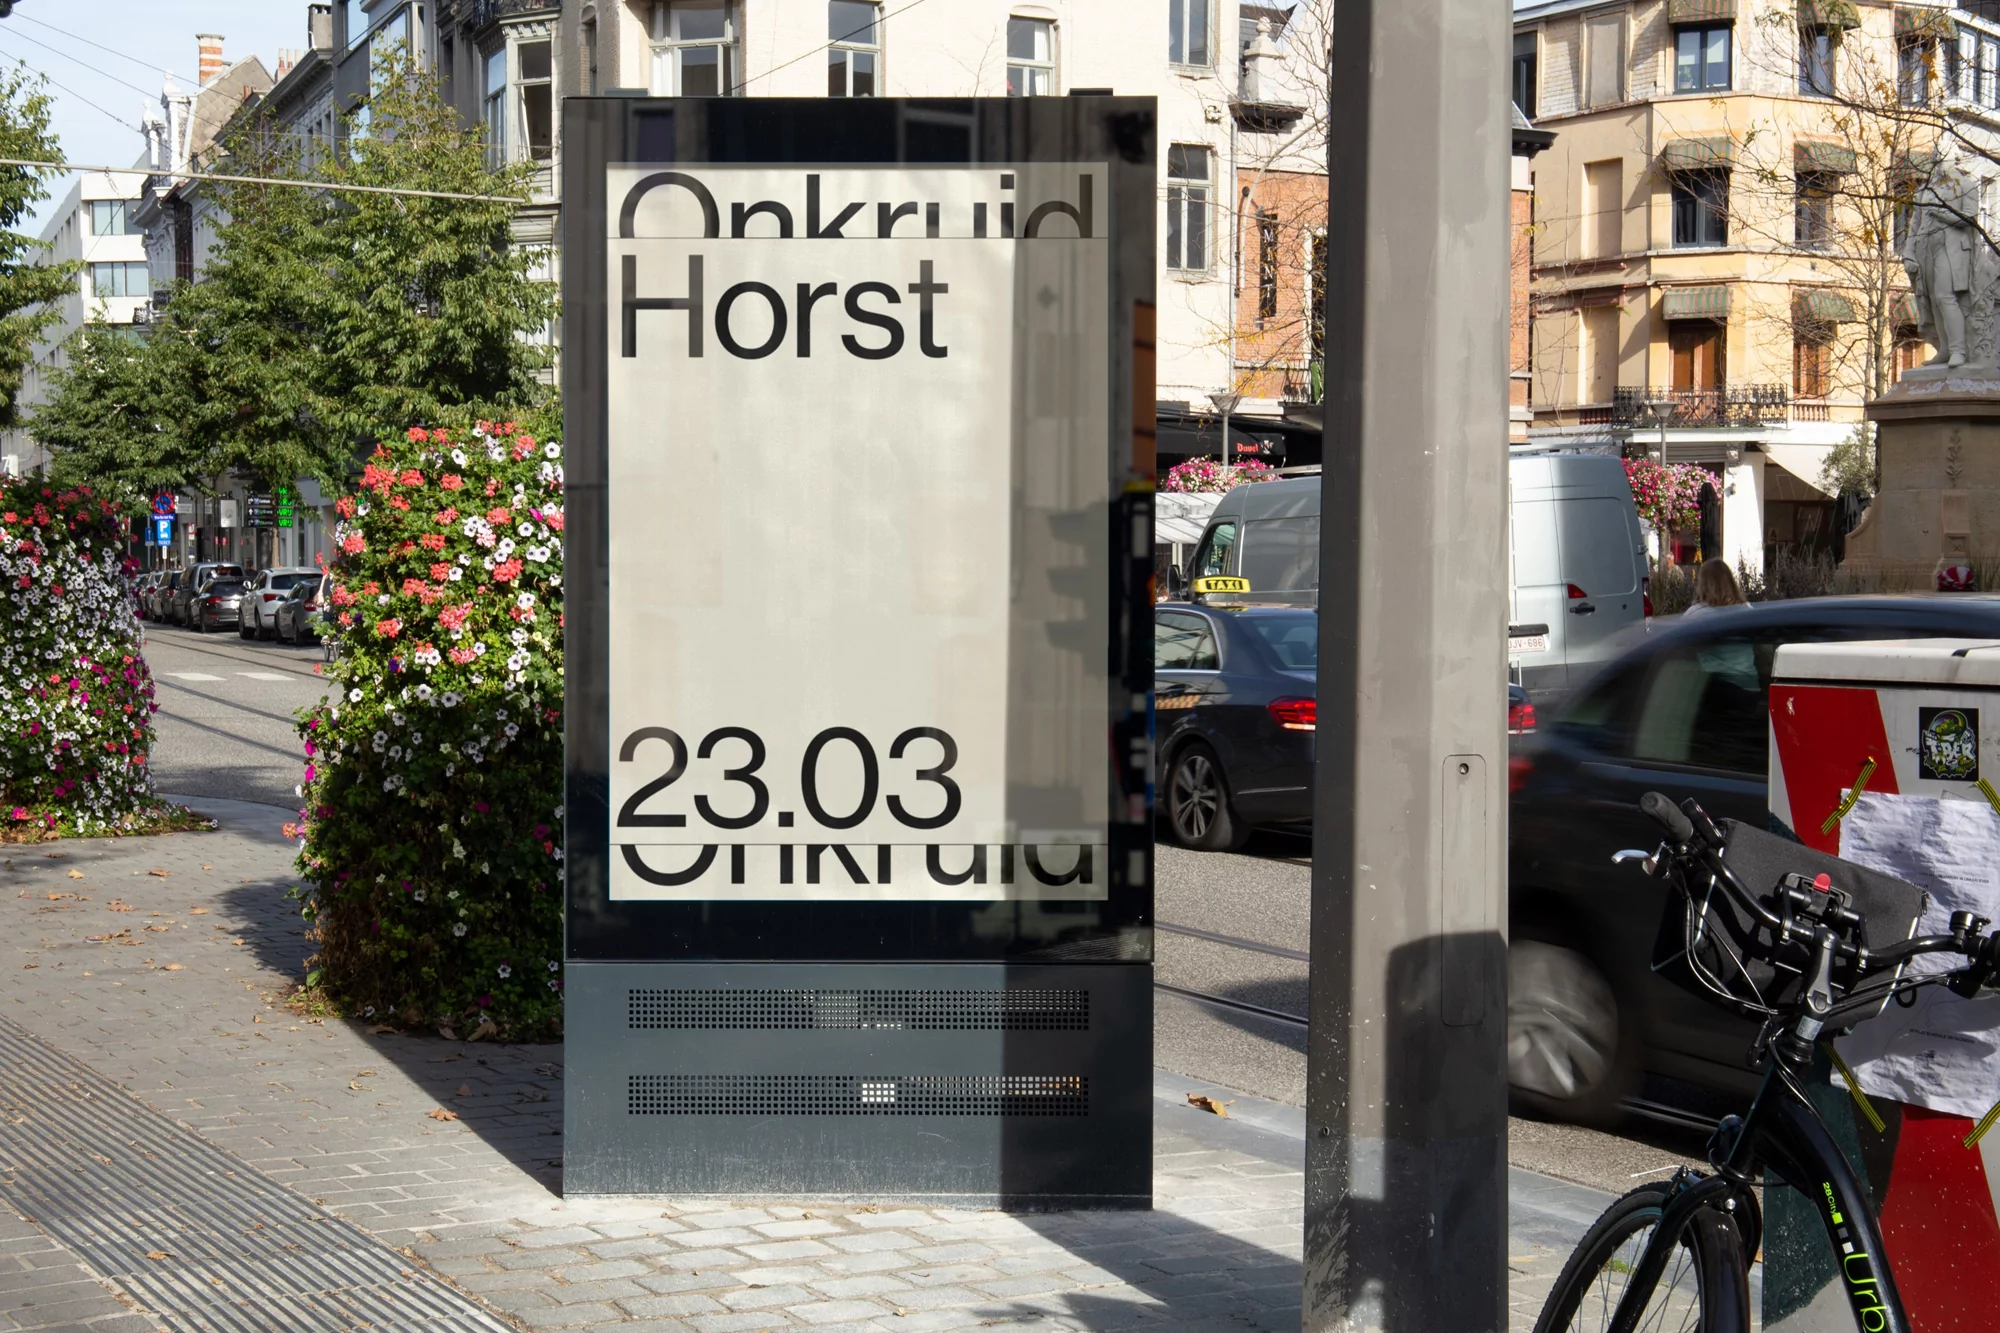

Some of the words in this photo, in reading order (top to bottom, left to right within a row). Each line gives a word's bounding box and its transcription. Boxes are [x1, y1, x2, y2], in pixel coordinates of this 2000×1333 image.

[1264, 229, 1274, 298] MINT
[621, 254, 949, 360] Horst
[1237, 443, 1259, 453] Duvel
[160, 521, 168, 532] P
[1207, 580, 1242, 591] TAXI
[616, 726, 962, 830] 23.03
[1823, 1182, 1837, 1214] 28City
[1844, 1253, 1887, 1333] Urb
